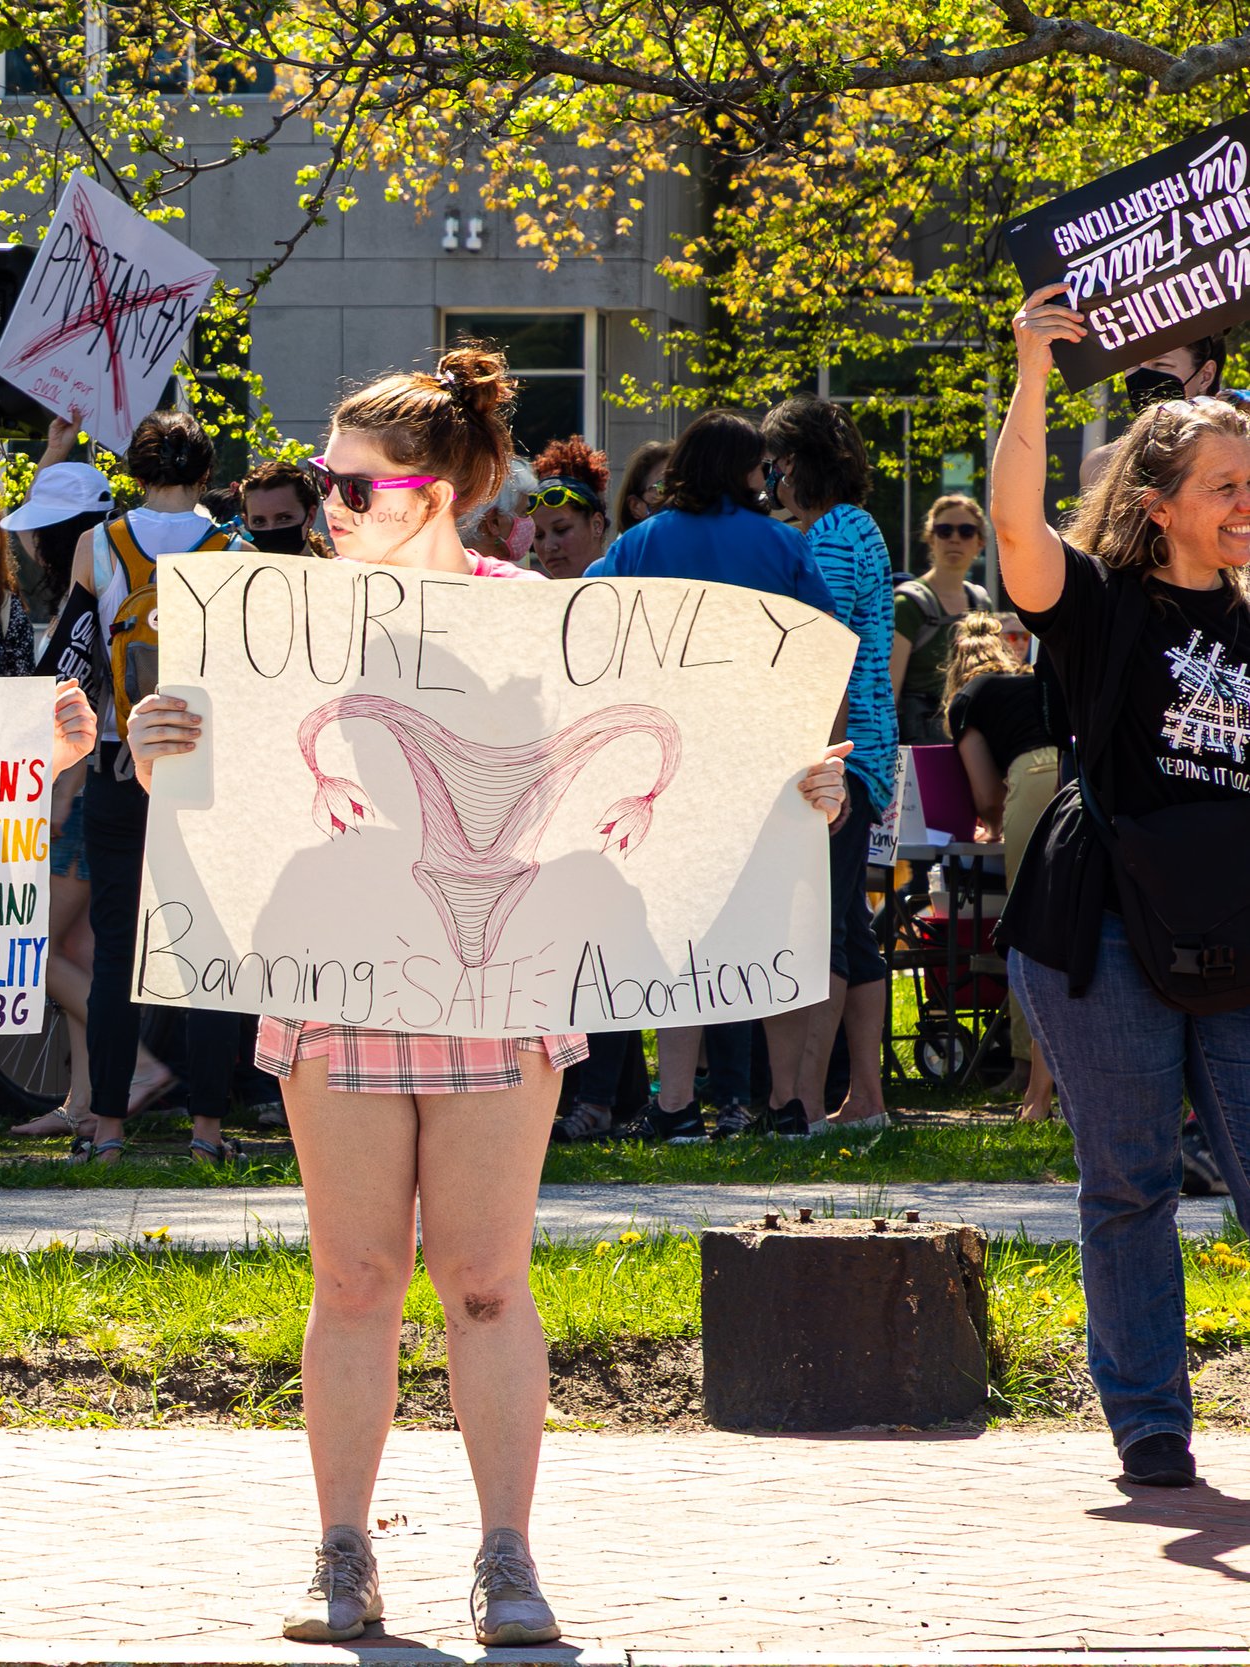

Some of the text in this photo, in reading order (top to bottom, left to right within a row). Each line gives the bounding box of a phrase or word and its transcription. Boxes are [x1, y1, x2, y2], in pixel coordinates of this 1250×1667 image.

[1053, 135, 1248, 256] Our ABORTIONS
[31, 222, 199, 379] PATRIARCHY
[1089, 262, 1227, 351] BODIES
[561, 581, 821, 687] ONLY
[1214, 767, 1228, 786] IT
[1230, 770, 1250, 794] LOC
[136, 901, 801, 1031] Banning SAFE Abortions
